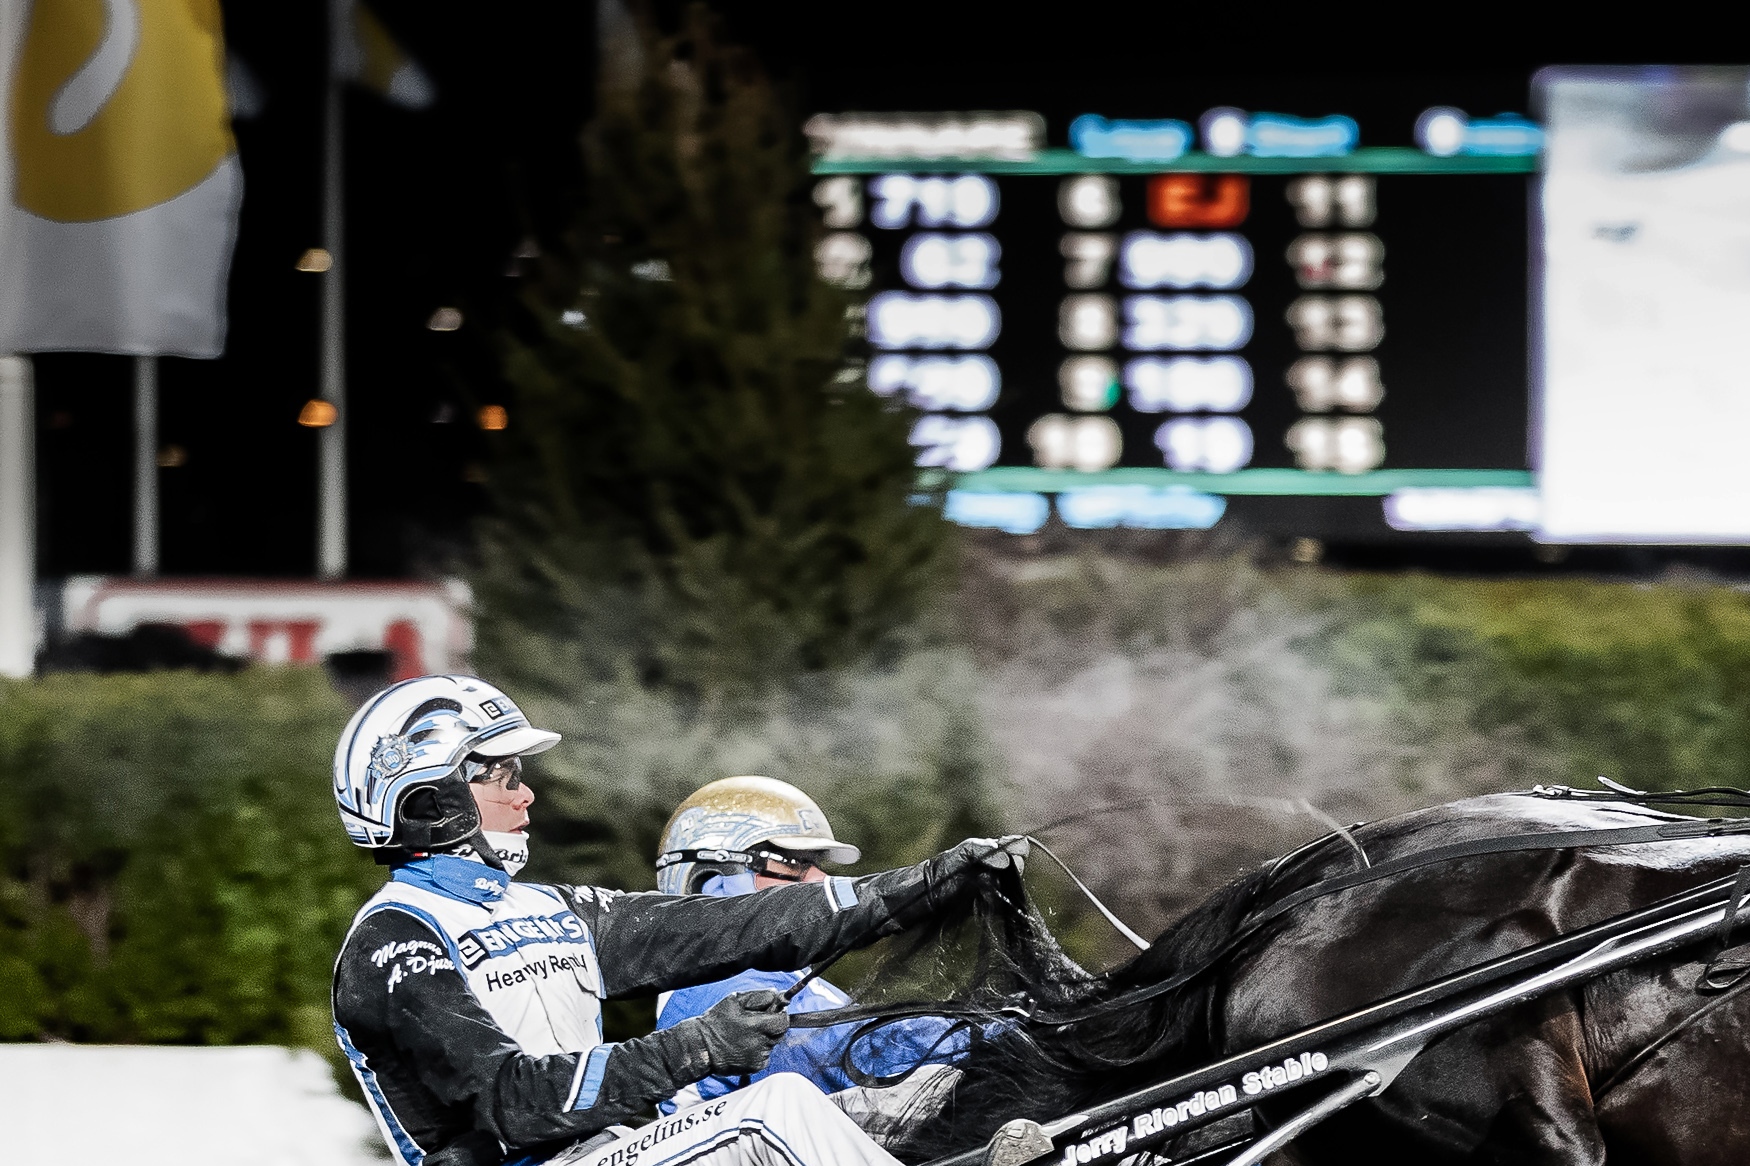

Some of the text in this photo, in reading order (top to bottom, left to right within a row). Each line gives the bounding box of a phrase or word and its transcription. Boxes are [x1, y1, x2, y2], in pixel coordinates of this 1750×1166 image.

[370, 939, 443, 968] Magnus
[387, 963, 408, 994] A.
[485, 959, 548, 992] Heavy
[1132, 1084, 1238, 1140] Riordan
[1241, 1051, 1329, 1095] Stable
